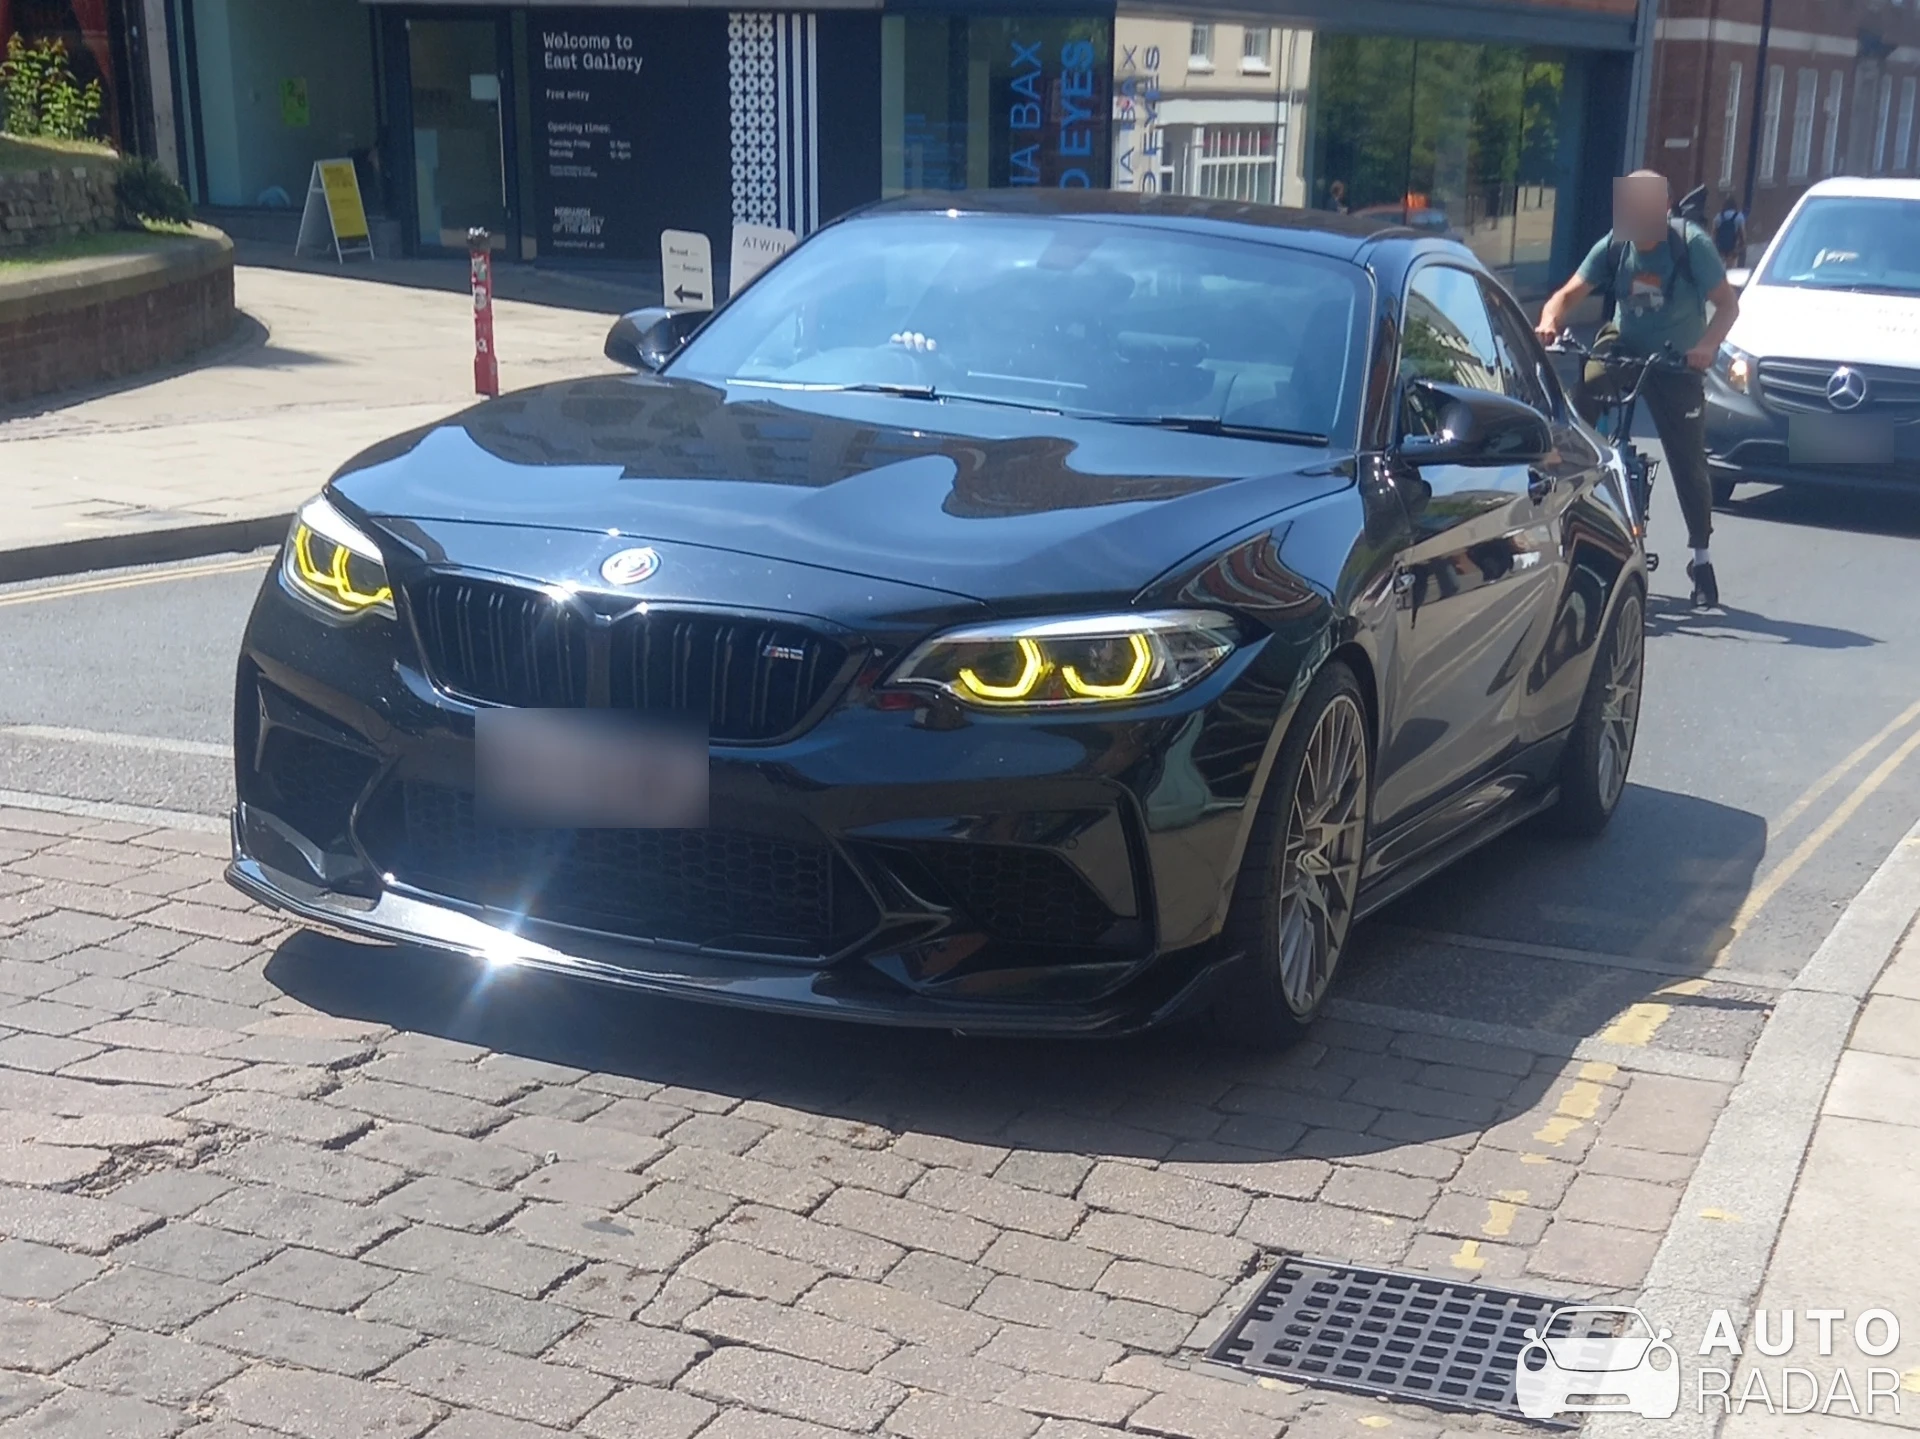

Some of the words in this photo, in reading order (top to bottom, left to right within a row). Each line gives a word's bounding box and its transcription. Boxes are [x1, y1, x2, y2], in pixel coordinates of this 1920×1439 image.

[543, 31, 610, 50] Welcome
[615, 33, 633, 51] to
[544, 51, 578, 70] East
[582, 52, 643, 75] Gallery
[1010, 40, 1042, 130] BAX
[1060, 39, 1095, 156] EYES
